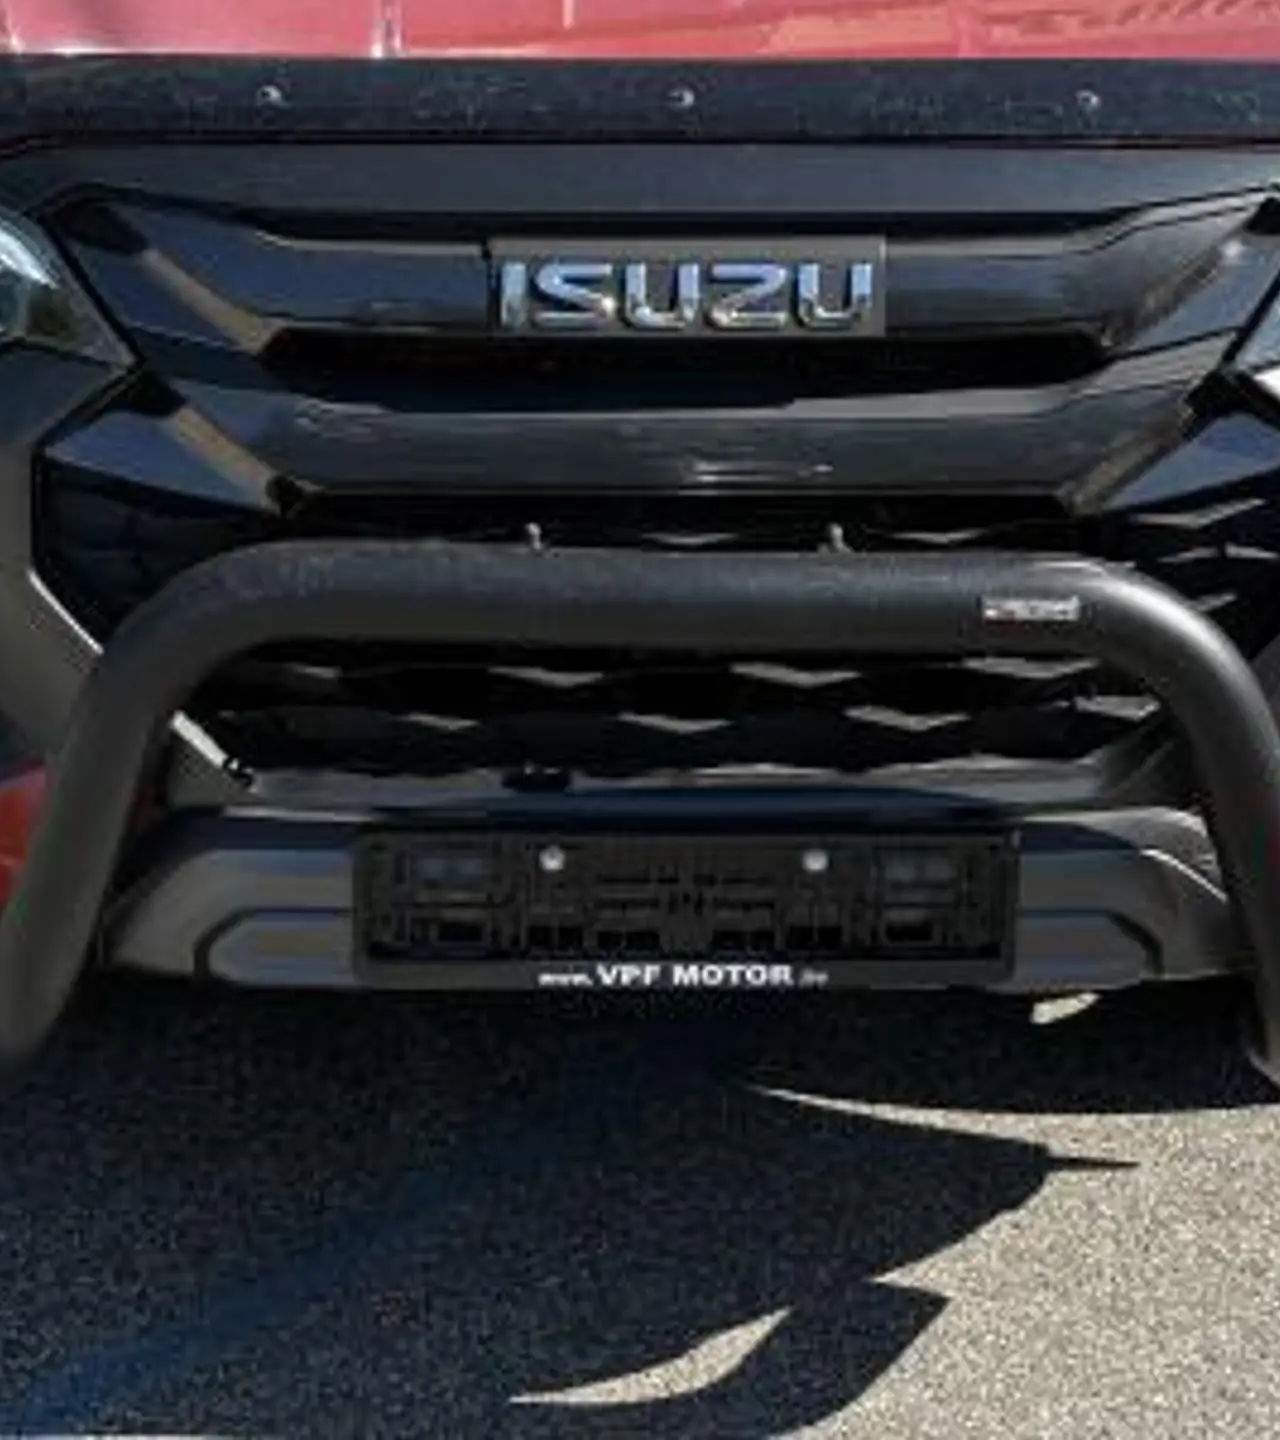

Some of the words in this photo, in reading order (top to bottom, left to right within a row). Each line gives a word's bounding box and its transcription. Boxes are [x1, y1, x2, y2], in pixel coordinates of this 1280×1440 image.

[500, 262, 874, 329] ISUZU
[595, 964, 662, 987] VPF
[672, 964, 796, 987] MOTOR
